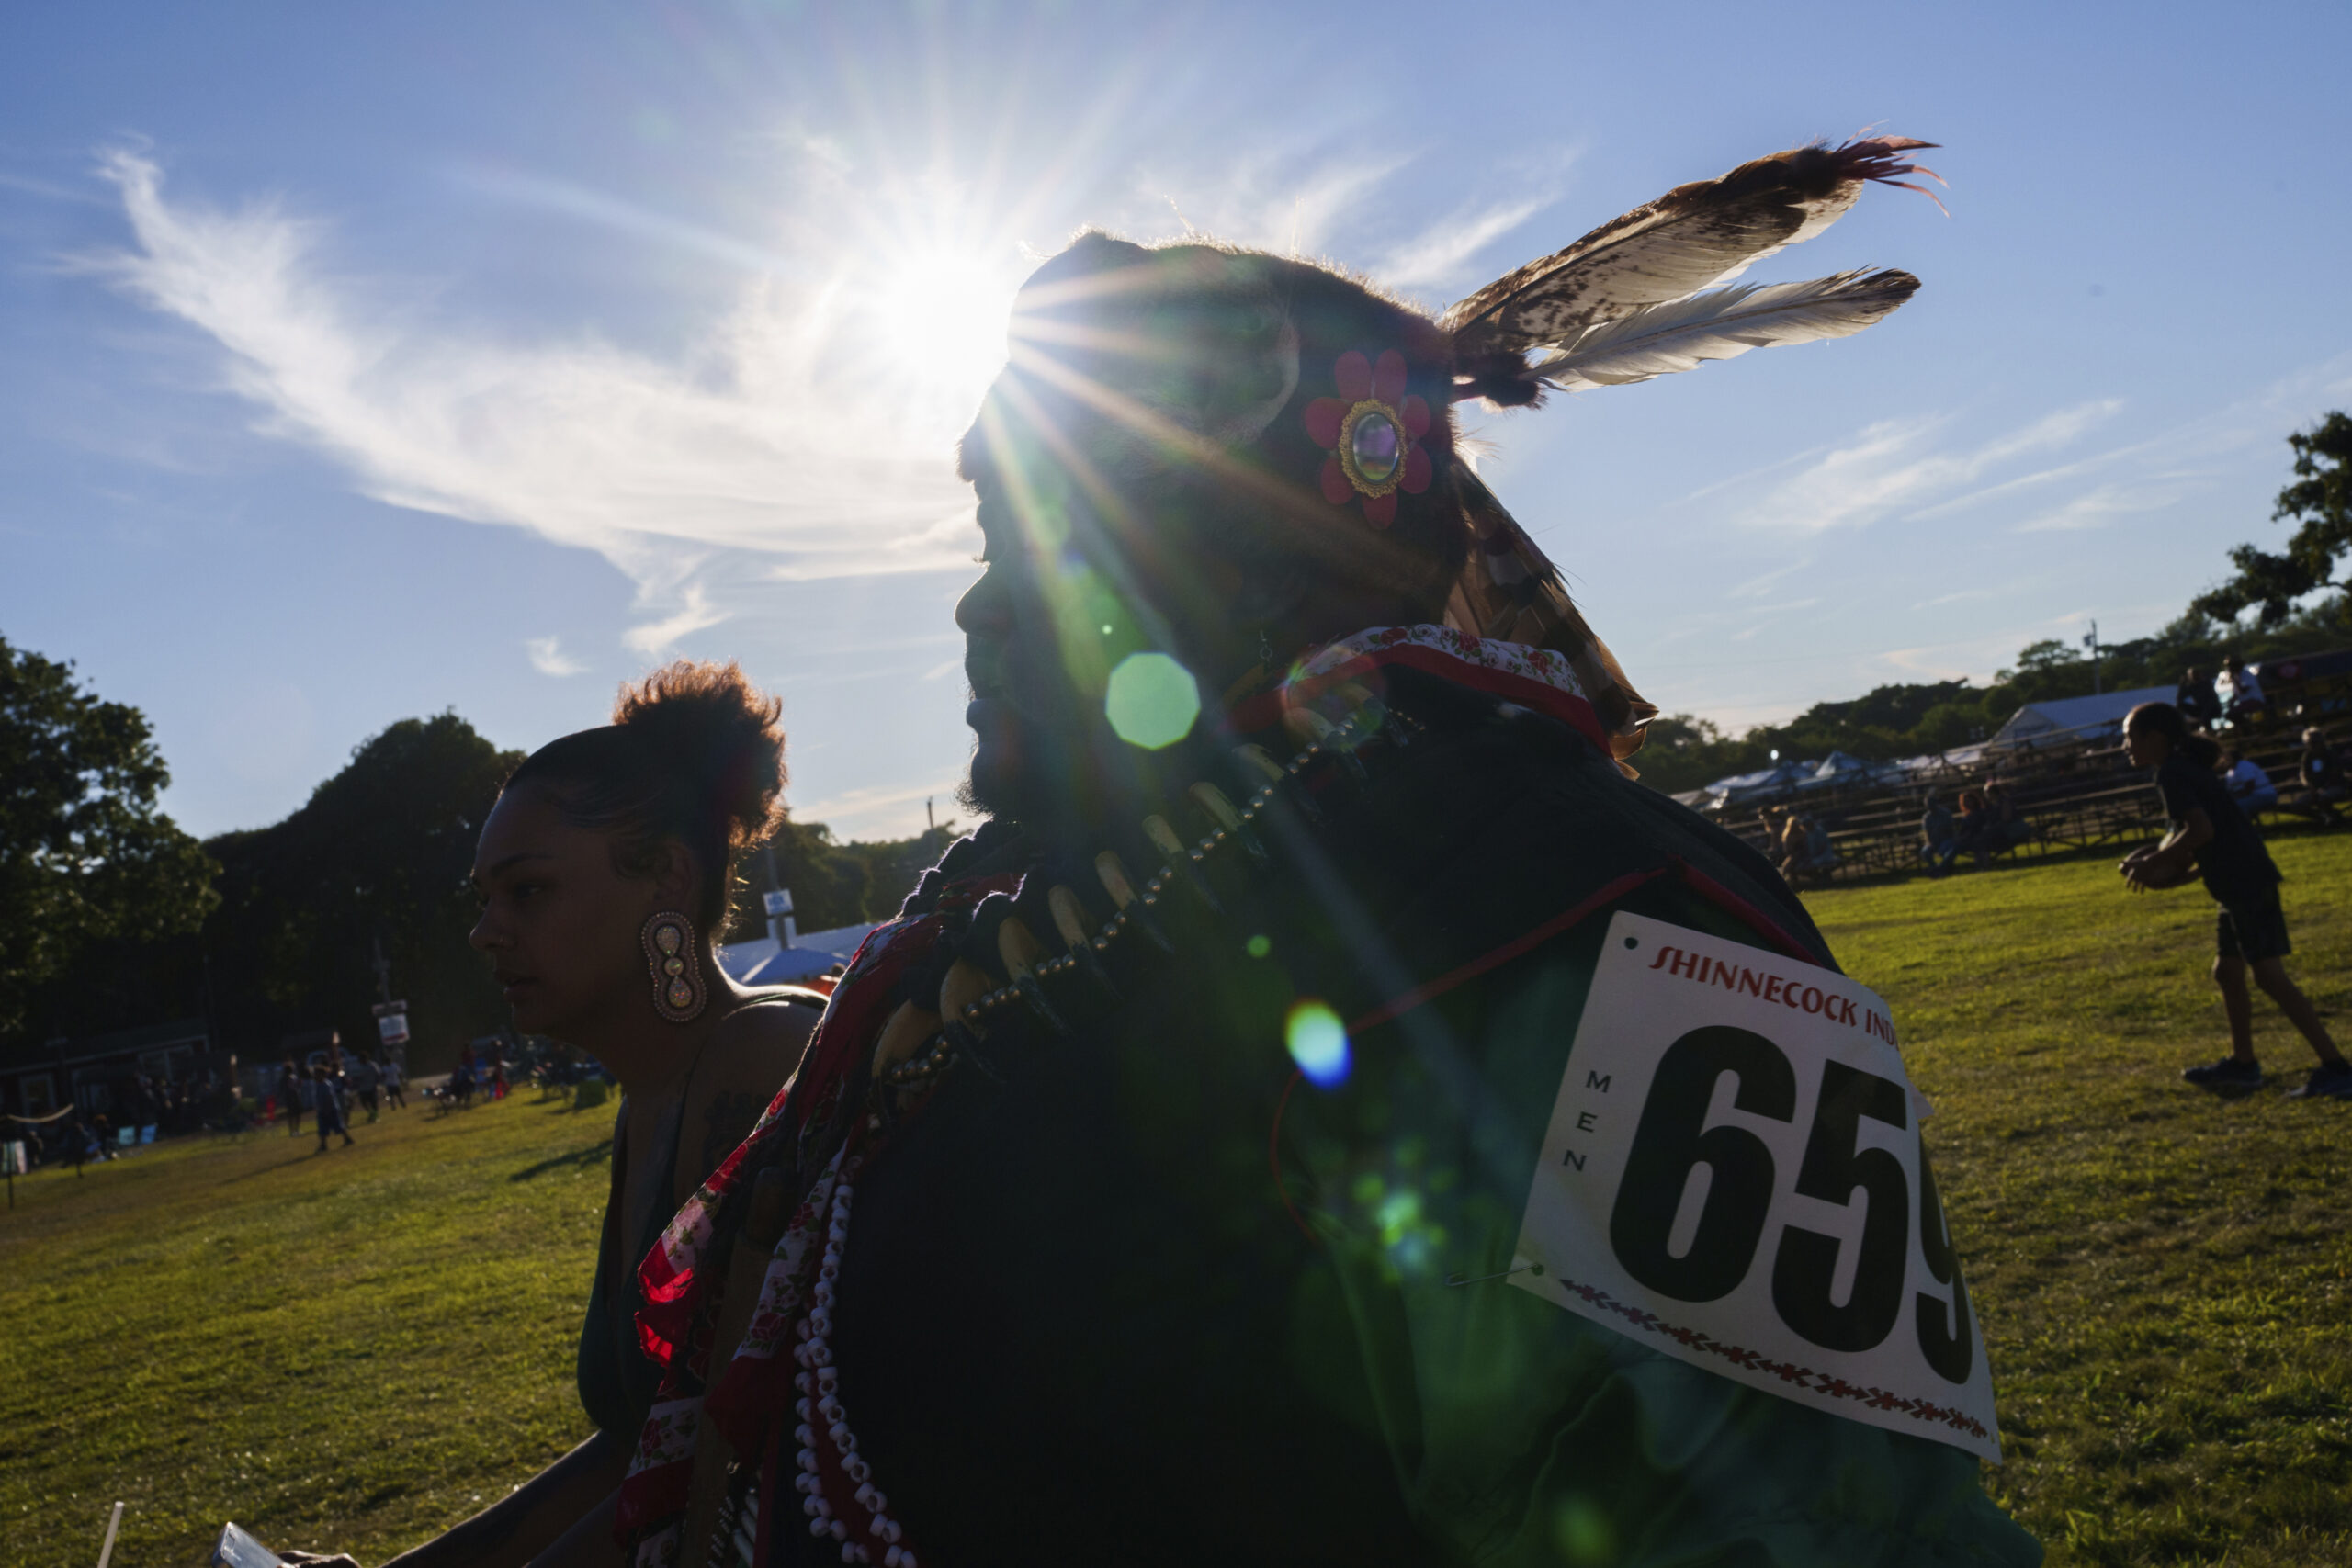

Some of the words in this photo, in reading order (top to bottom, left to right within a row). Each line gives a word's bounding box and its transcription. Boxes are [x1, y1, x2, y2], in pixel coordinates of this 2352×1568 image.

[1649, 947, 1858, 1026] SHINNECOCK
[1563, 1070, 1611, 1172] MEN
[1610, 1025, 1973, 1384] 659
